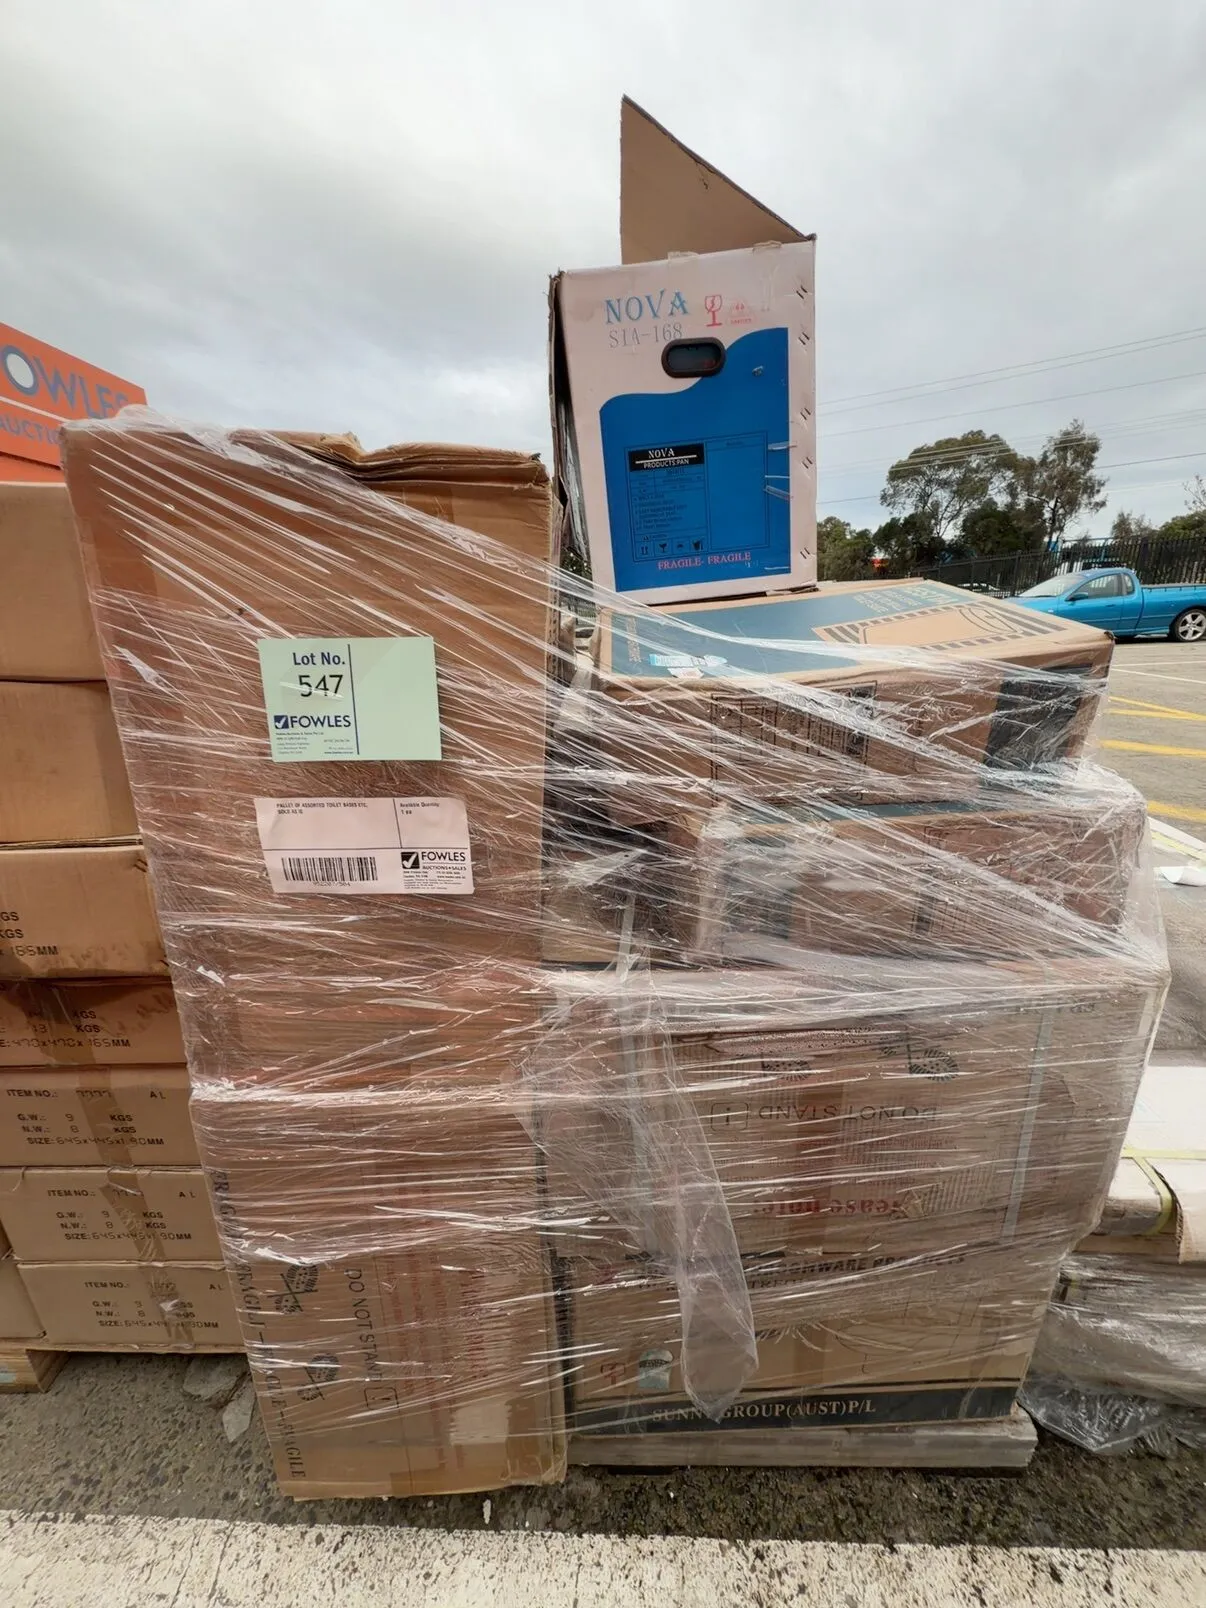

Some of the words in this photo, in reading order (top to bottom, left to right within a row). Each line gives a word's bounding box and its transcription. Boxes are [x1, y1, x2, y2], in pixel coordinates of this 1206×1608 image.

[605, 288, 690, 325] NOVA
[648, 447, 676, 459] NOVA
[708, 552, 752, 565] FRAGILE
[292, 652, 316, 666] Lot
[321, 651, 346, 666] No.
[298, 674, 344, 698] 547
[290, 715, 352, 729] FOWLES
[421, 851, 466, 862] FOWLES
[75, 1024, 101, 1033] KGS
[64, 1113, 75, 1122] 9
[109, 1114, 133, 1122] KGS
[757, 1104, 838, 1121] STAND
[142, 1211, 164, 1219] KGS
[345, 1268, 365, 1293] DO
[352, 1298, 373, 1330] NOT
[652, 1406, 716, 1423] SUNN
